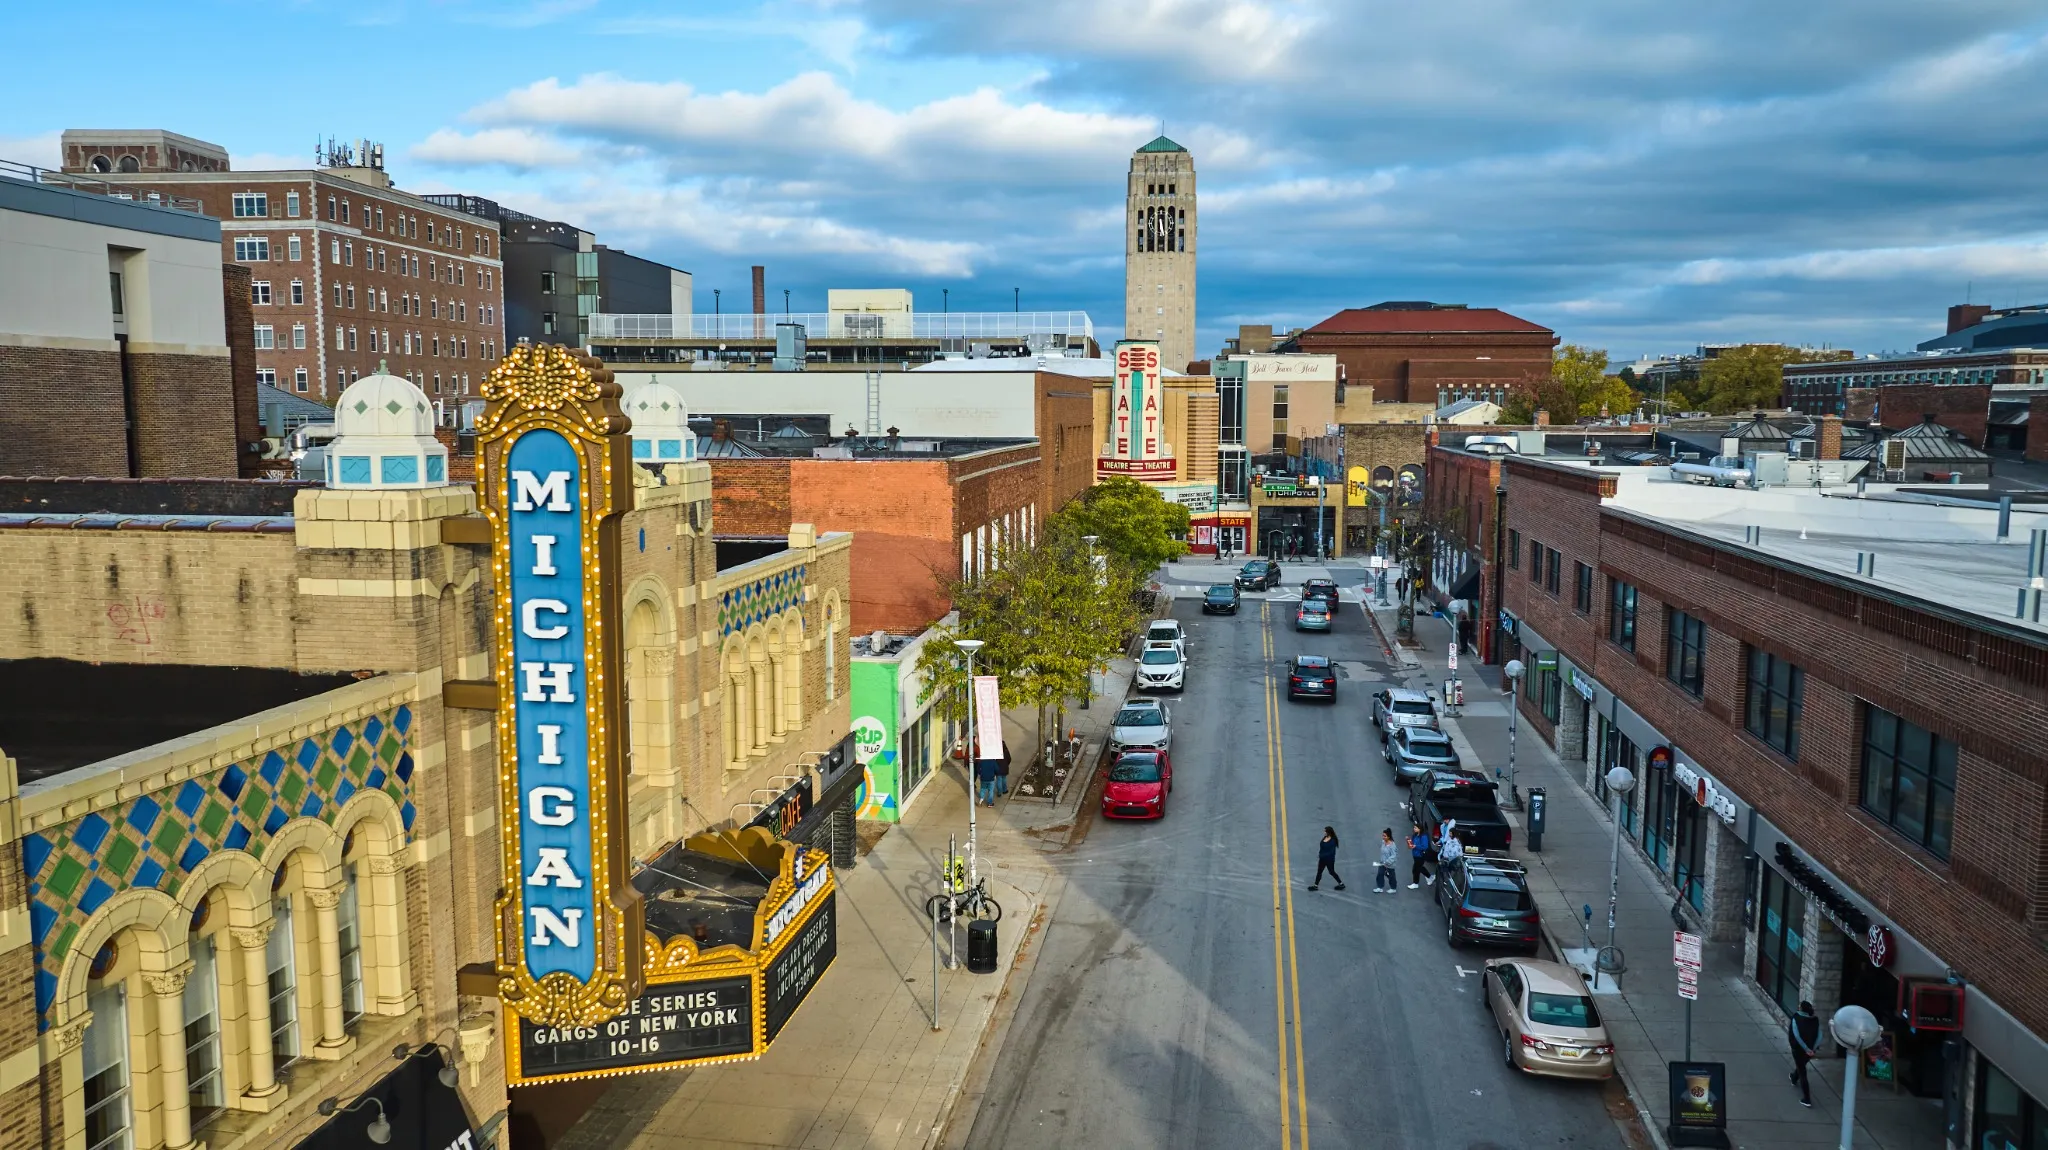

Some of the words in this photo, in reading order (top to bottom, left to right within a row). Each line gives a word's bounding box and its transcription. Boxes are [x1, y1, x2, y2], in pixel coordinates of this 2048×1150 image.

[1249, 361, 1267, 374] Bell
[1269, 361, 1292, 374] Tower
[1294, 361, 1319, 374] Hotel
[1117, 351, 1130, 454] STATE
[1145, 351, 1158, 454] STATE
[1102, 461, 1129, 470] THEATRE
[1144, 461, 1171, 470] THEATRE
[511, 470, 583, 948] MICHIGAN
[781, 793, 802, 837] CAFE
[777, 961, 789, 982] THE
[790, 948, 801, 967] ARK
[803, 911, 829, 947] PRESENTS
[777, 964, 801, 1001] LUCINDA
[803, 928, 828, 967] WILLIAMS
[795, 965, 815, 997] 7:30PM
[651, 991, 717, 1013] SERIES
[534, 1024, 598, 1045] GANGS
[607, 1020, 630, 1037] OF
[640, 1015, 677, 1034] NEW
[687, 1008, 738, 1028] YORK
[610, 1036, 660, 1056] 10-16
